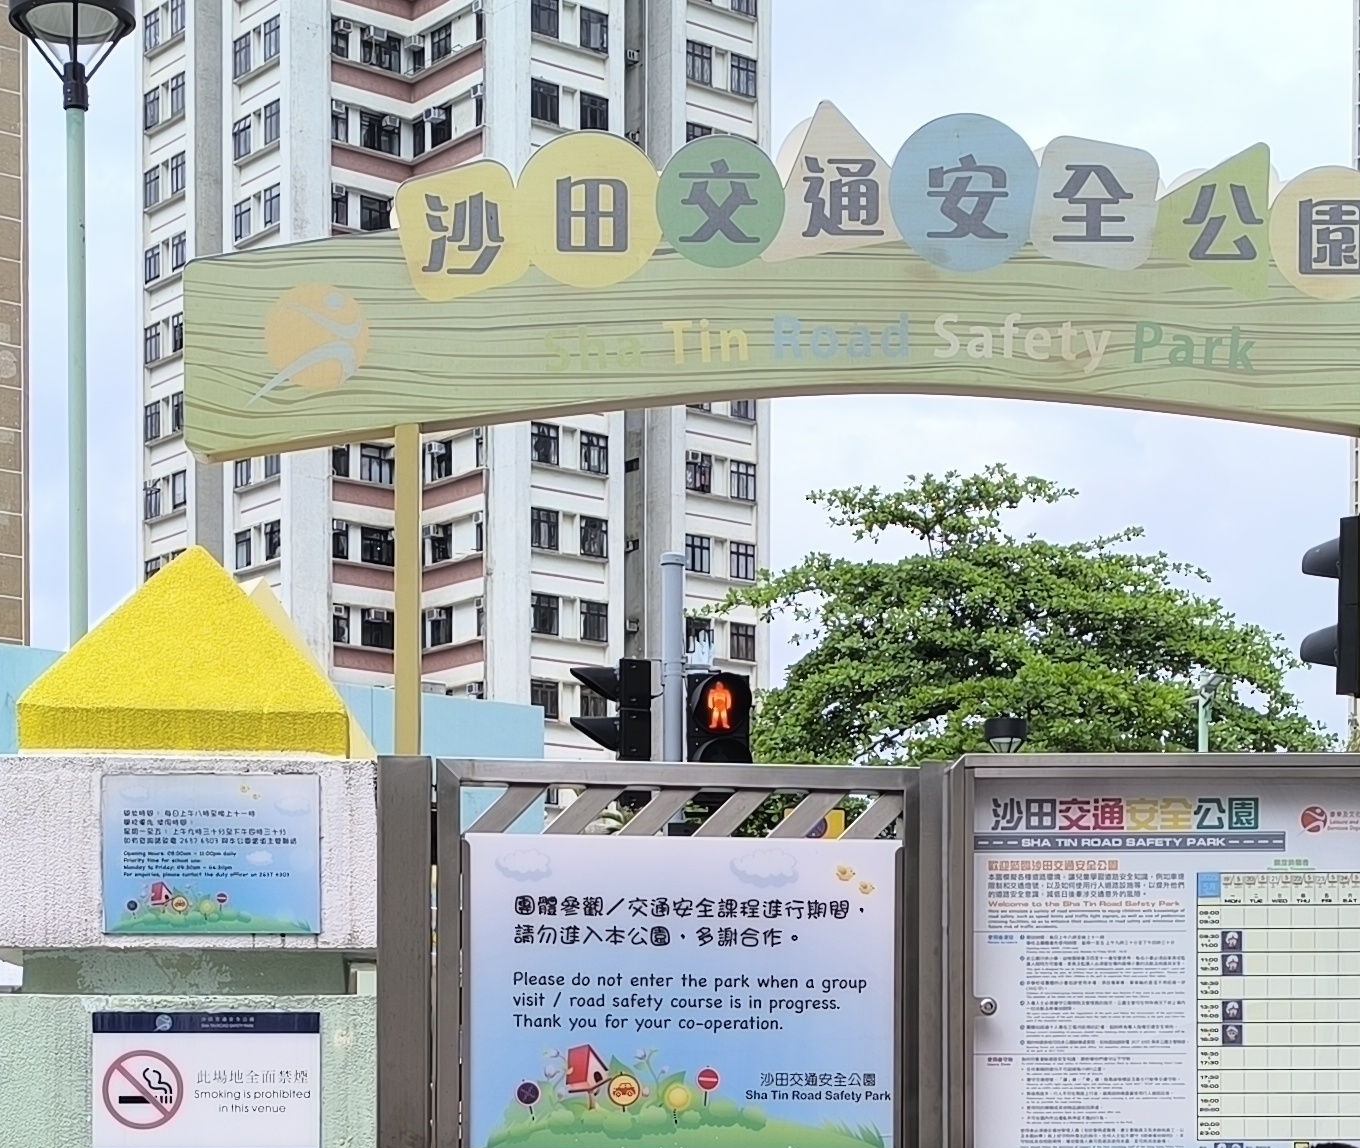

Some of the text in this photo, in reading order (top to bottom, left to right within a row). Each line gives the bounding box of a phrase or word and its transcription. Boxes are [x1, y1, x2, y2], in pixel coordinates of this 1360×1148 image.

[544, 313, 1258, 375] Sha Tin Road Safety Park
[990, 797, 1260, 832] 沙田交通安全公園
[1020, 836, 1226, 848] SHA TIN ROAD SAFETY PARK
[1125, 900, 1156, 908] Safety
[512, 970, 868, 994] Please do not enter the park when a group
[512, 992, 842, 1015] visit / road safety course is in progress.
[512, 1013, 785, 1035] Thank you for your co-operation.
[196, 1069, 309, 1084] 此場地全面禁煙
[759, 1071, 877, 1088] 沙田交通安全公園
[194, 1089, 311, 1101] Smoking is prohibited
[745, 1089, 892, 1103] Sha Tin Road Safety Park
[218, 1104, 287, 1113] in this venue
